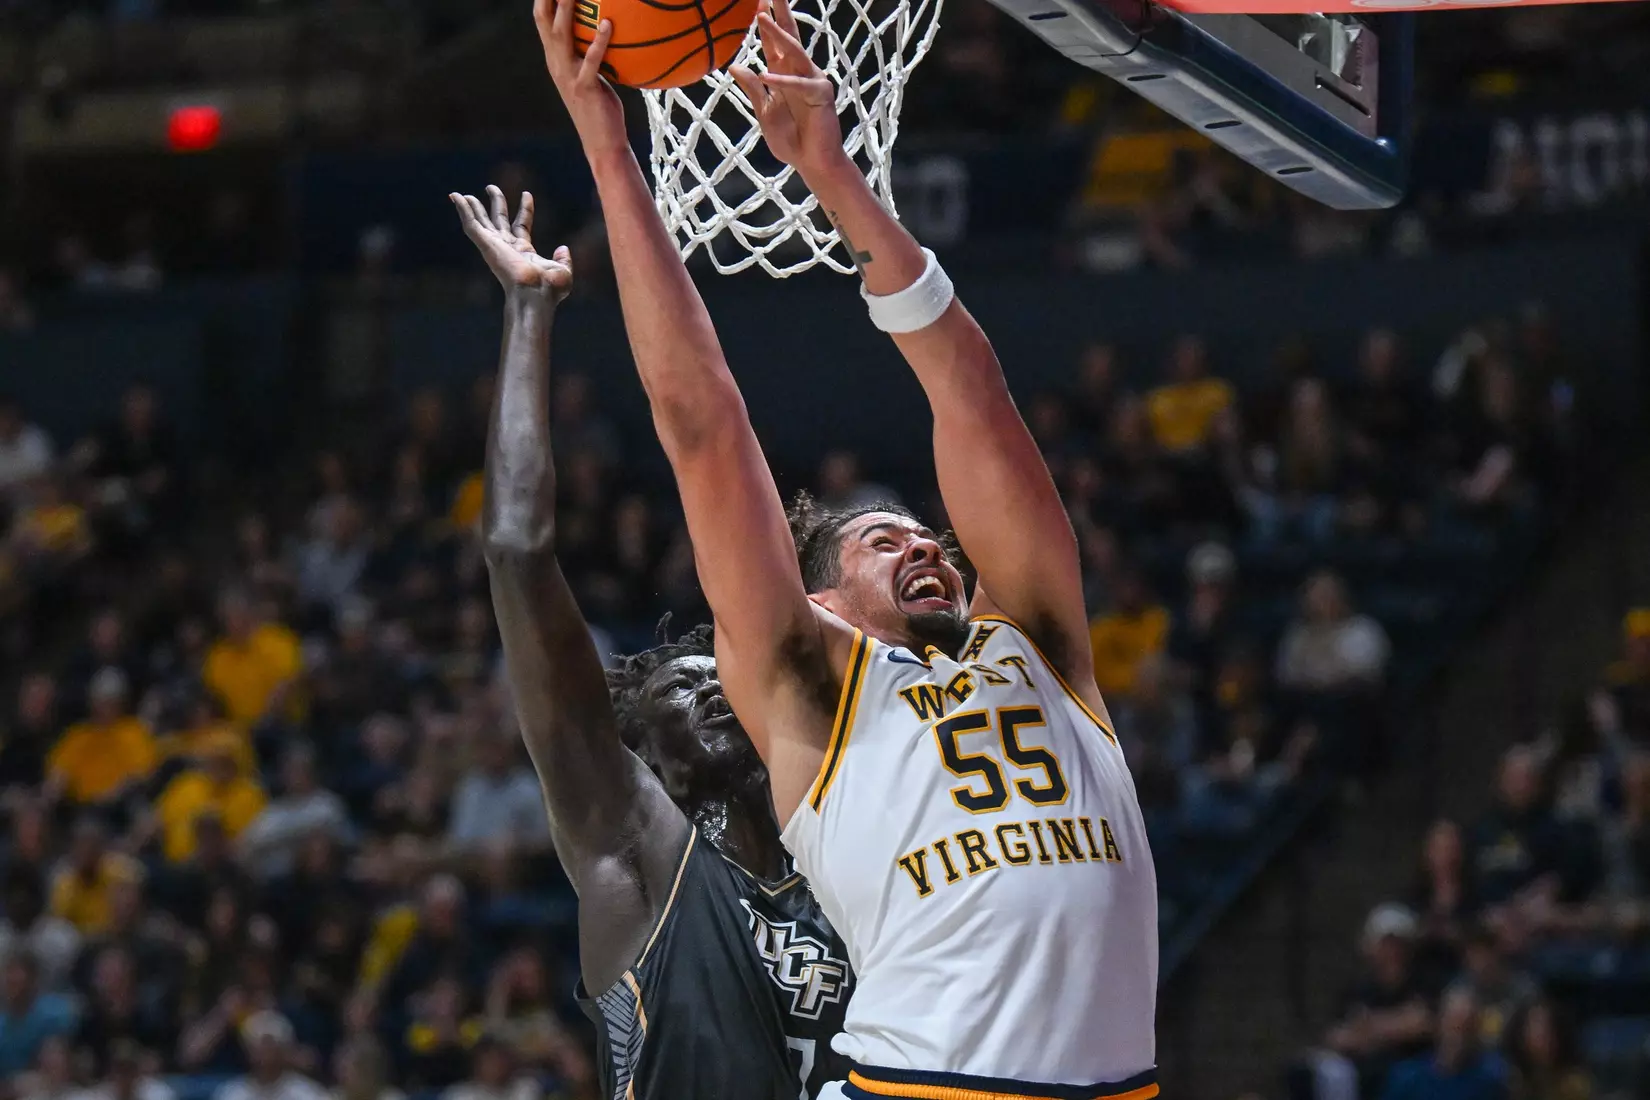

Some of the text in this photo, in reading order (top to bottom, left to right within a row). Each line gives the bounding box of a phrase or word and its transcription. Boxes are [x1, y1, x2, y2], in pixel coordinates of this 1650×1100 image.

[898, 656, 1036, 722] WEST
[932, 705, 1071, 815] 55
[897, 816, 1123, 899] VIRGINIA
[741, 901, 848, 1020] UCF
